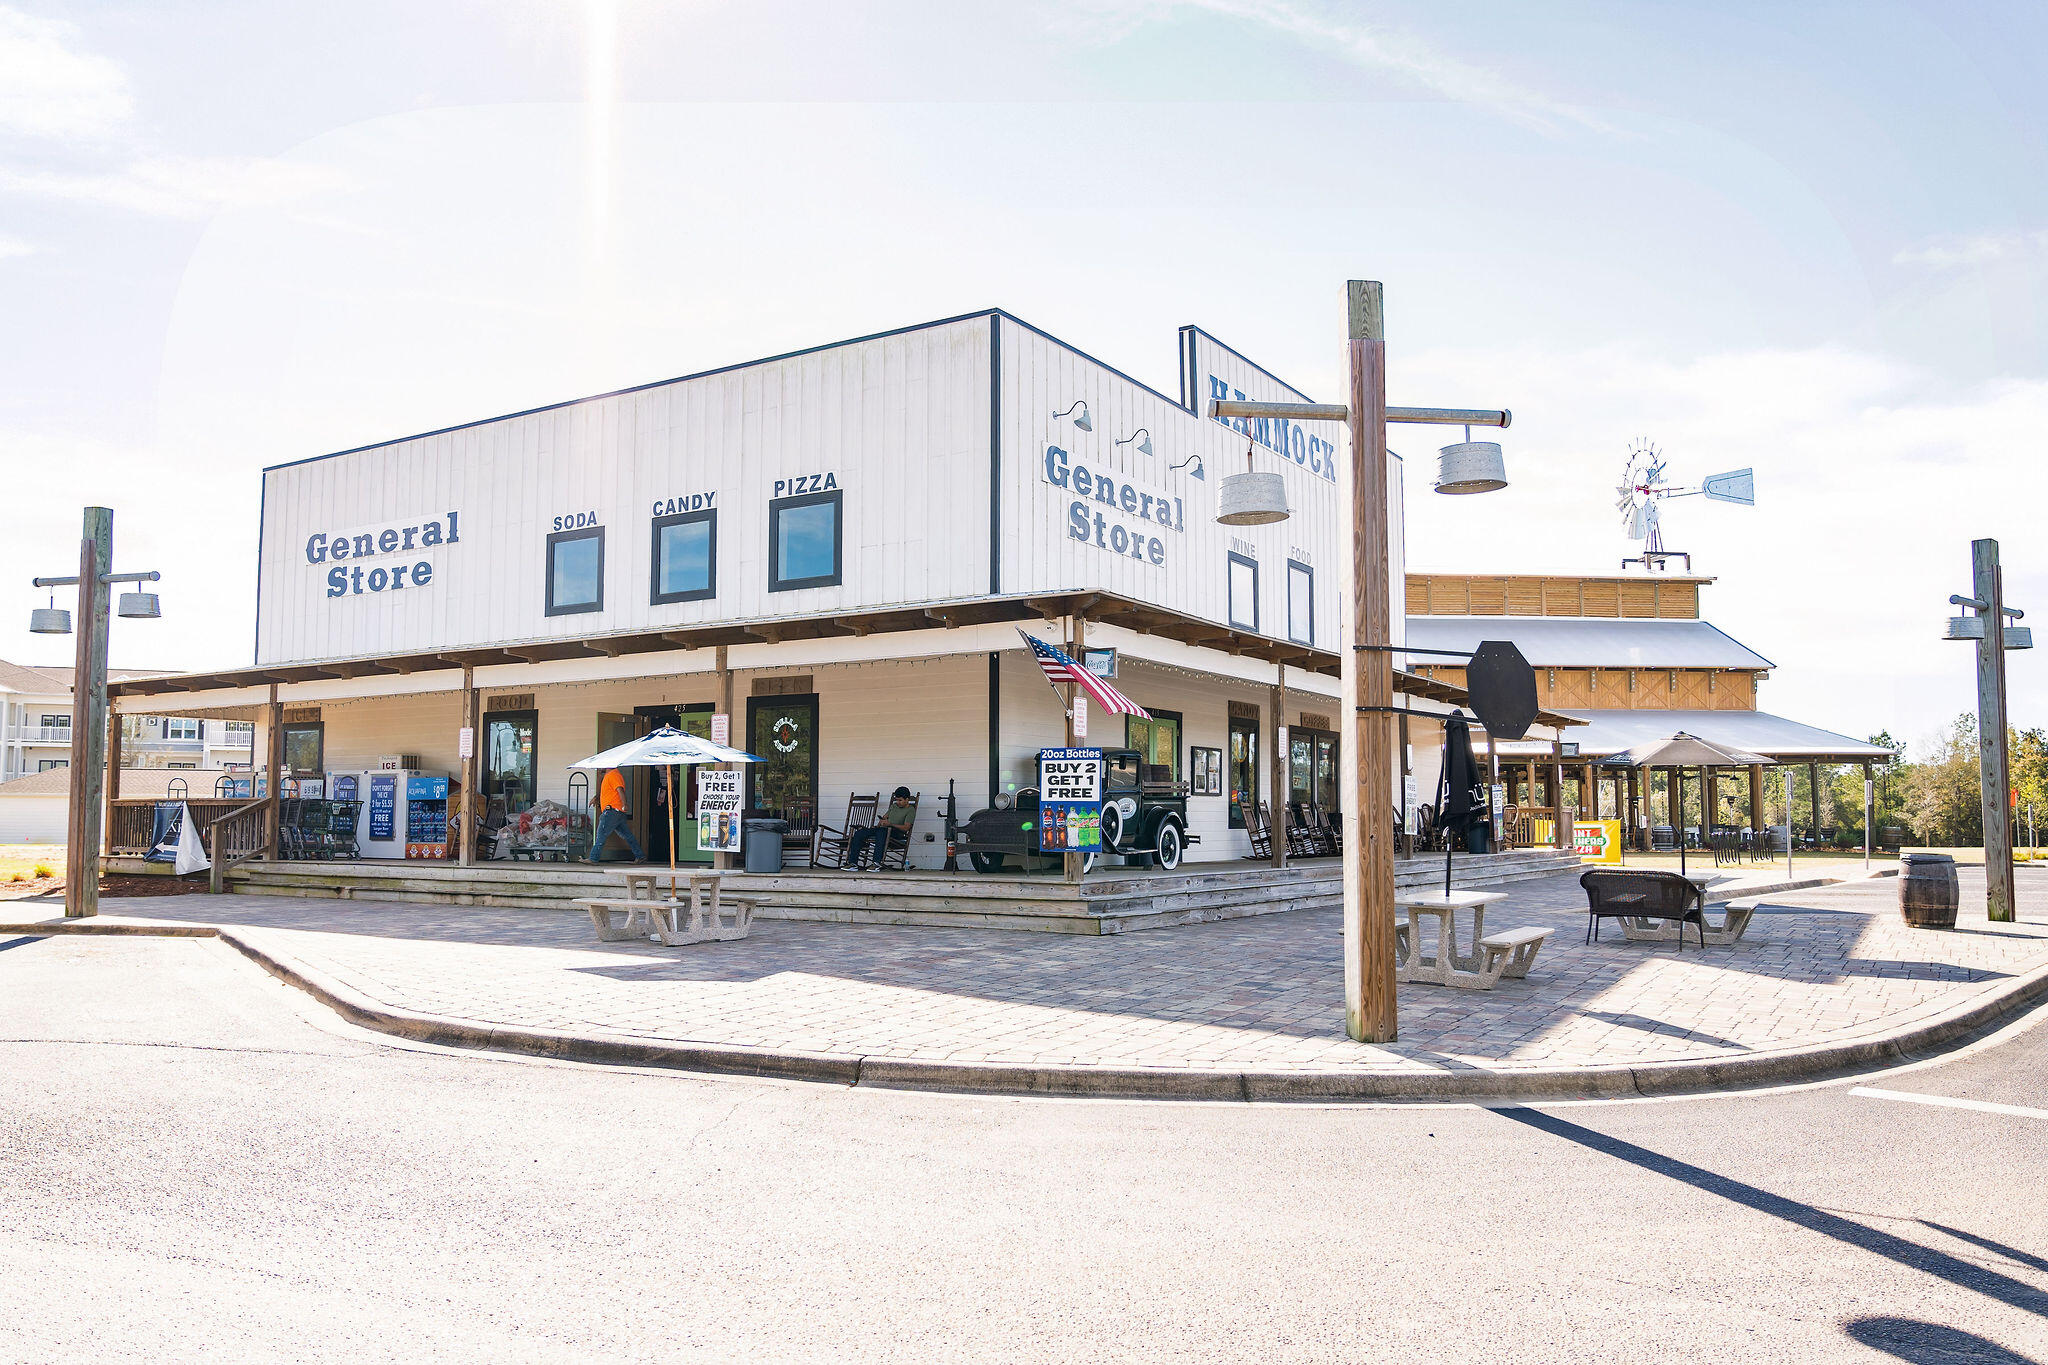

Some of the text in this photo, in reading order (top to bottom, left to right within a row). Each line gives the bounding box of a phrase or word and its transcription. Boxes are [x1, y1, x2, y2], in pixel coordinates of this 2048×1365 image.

[1209, 374, 1336, 482] HAMMOCK
[774, 472, 838, 498] PIZZA
[1045, 445, 1184, 532] General
[653, 491, 716, 516] CANDY
[553, 510, 598, 532] SODA
[306, 511, 459, 564] General
[1070, 501, 1164, 565] Store
[1232, 536, 1256, 558] WINE
[1291, 546, 1312, 564] FOOD
[327, 562, 432, 598] Store
[1041, 749, 1100, 758] 20oz Bottles
[382, 762, 396, 770] ICE
[1045, 763, 1096, 774] BUY 2
[700, 772, 714, 780] Buy
[714, 772, 720, 780] 2,
[722, 772, 735, 780] Get
[1048, 775, 1094, 786] GET 1
[705, 782, 735, 792] FREE
[1048, 788, 1093, 798] FREE
[700, 800, 738, 810] ENERGY
[374, 814, 389, 822] FREE
